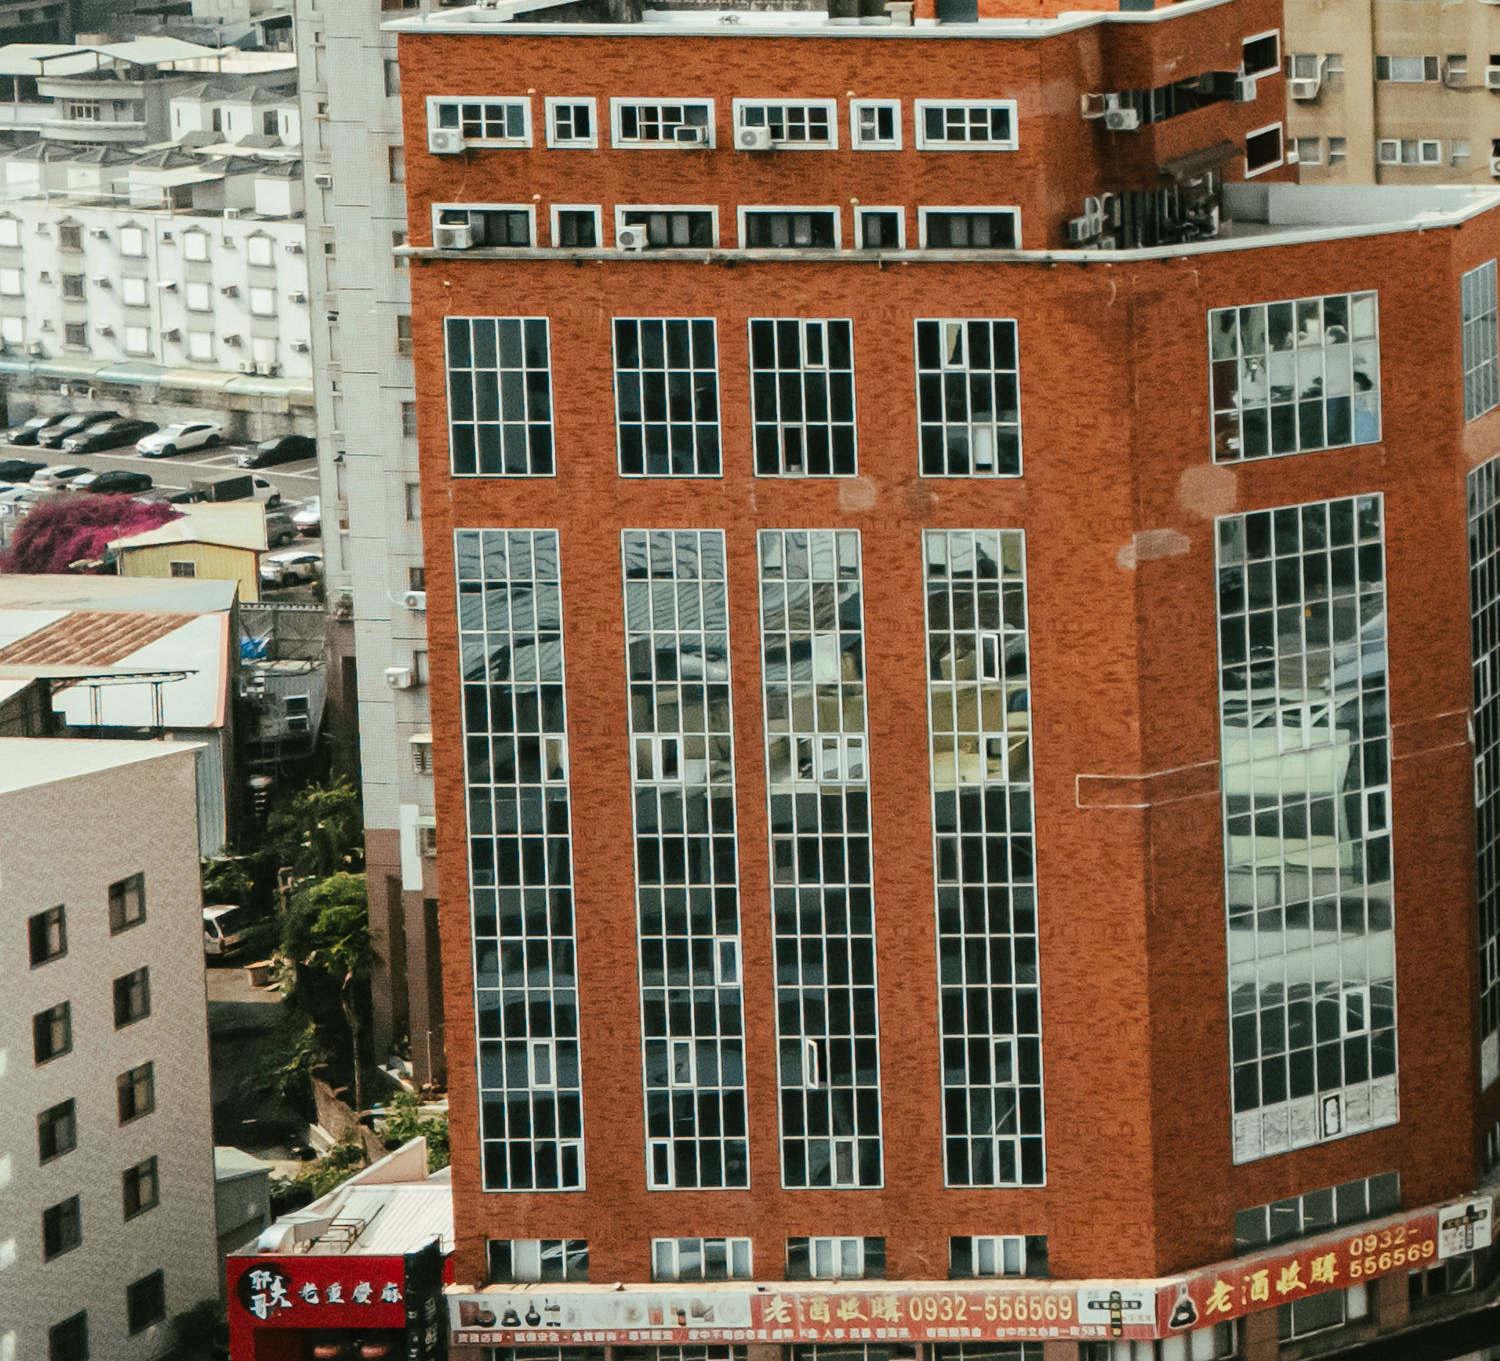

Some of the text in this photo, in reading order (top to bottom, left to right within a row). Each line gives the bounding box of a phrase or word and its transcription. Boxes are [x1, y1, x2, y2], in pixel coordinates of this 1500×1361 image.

[1206, 1253, 1339, 1315] 老酒收購
[1350, 1226, 1418, 1256] 0932-
[1350, 1240, 1434, 1278] 556569
[764, 1295, 903, 1324] 老酒收購
[909, 1295, 1073, 1322] 0932-556569
